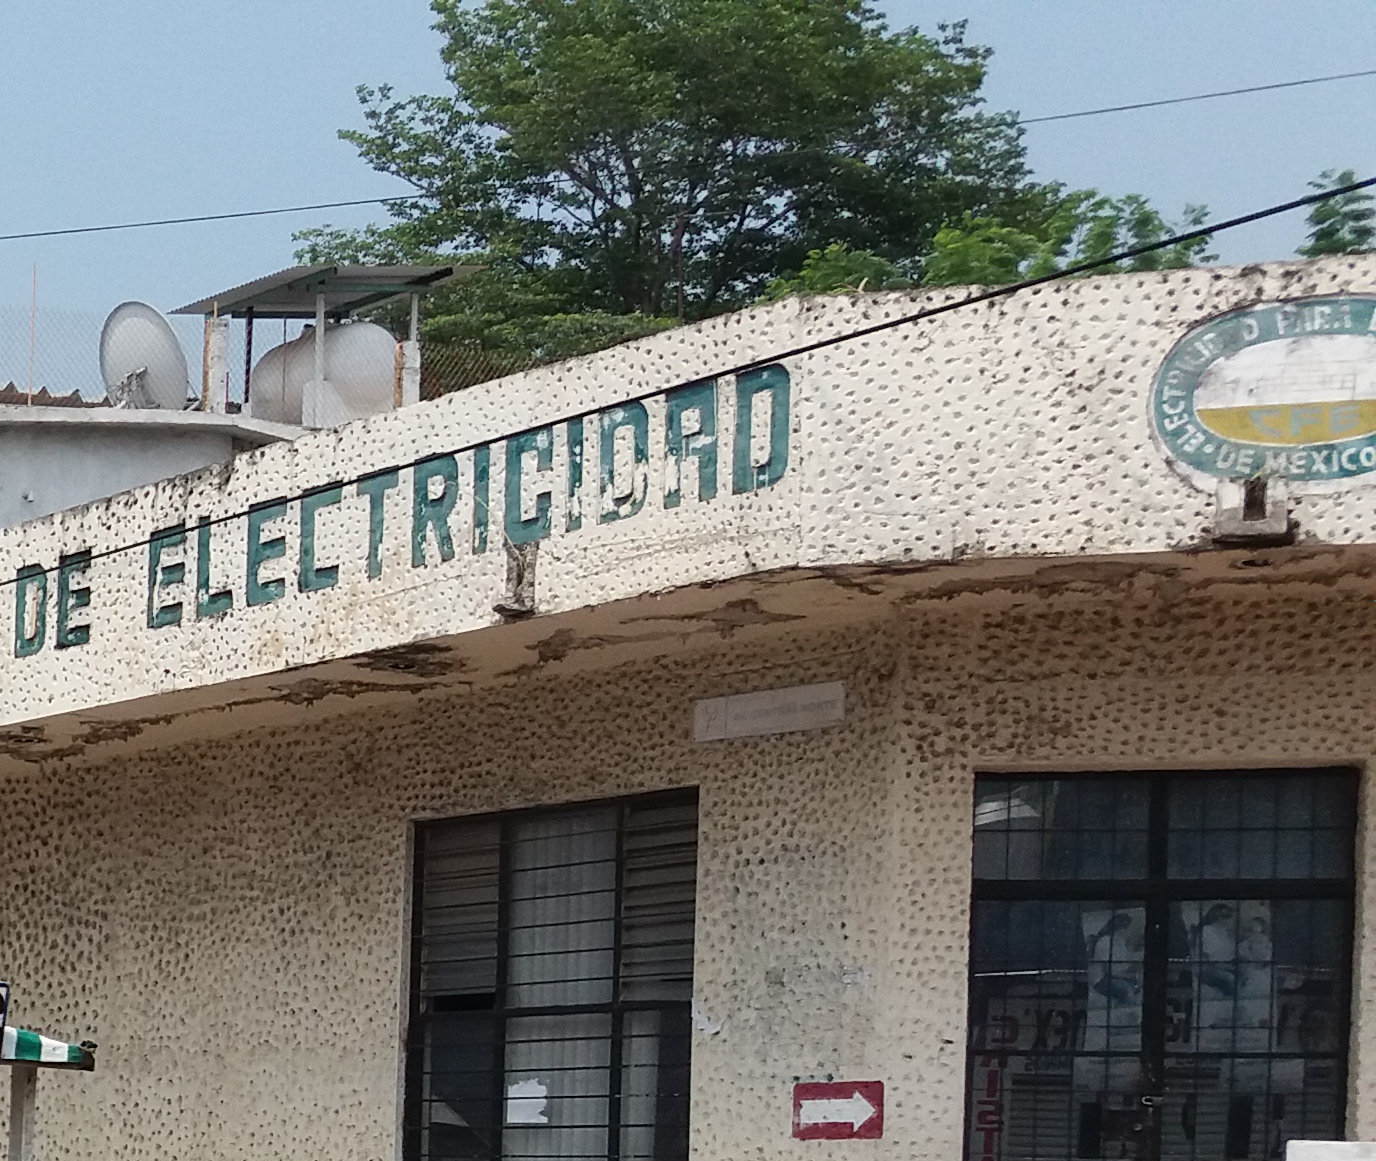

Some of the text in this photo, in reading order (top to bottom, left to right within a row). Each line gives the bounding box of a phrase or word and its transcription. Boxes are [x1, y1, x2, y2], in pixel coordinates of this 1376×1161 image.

[14, 547, 92, 659] DE
[147, 362, 792, 629] ELECTRICIDAD
[1265, 446, 1376, 474] MEXICO
